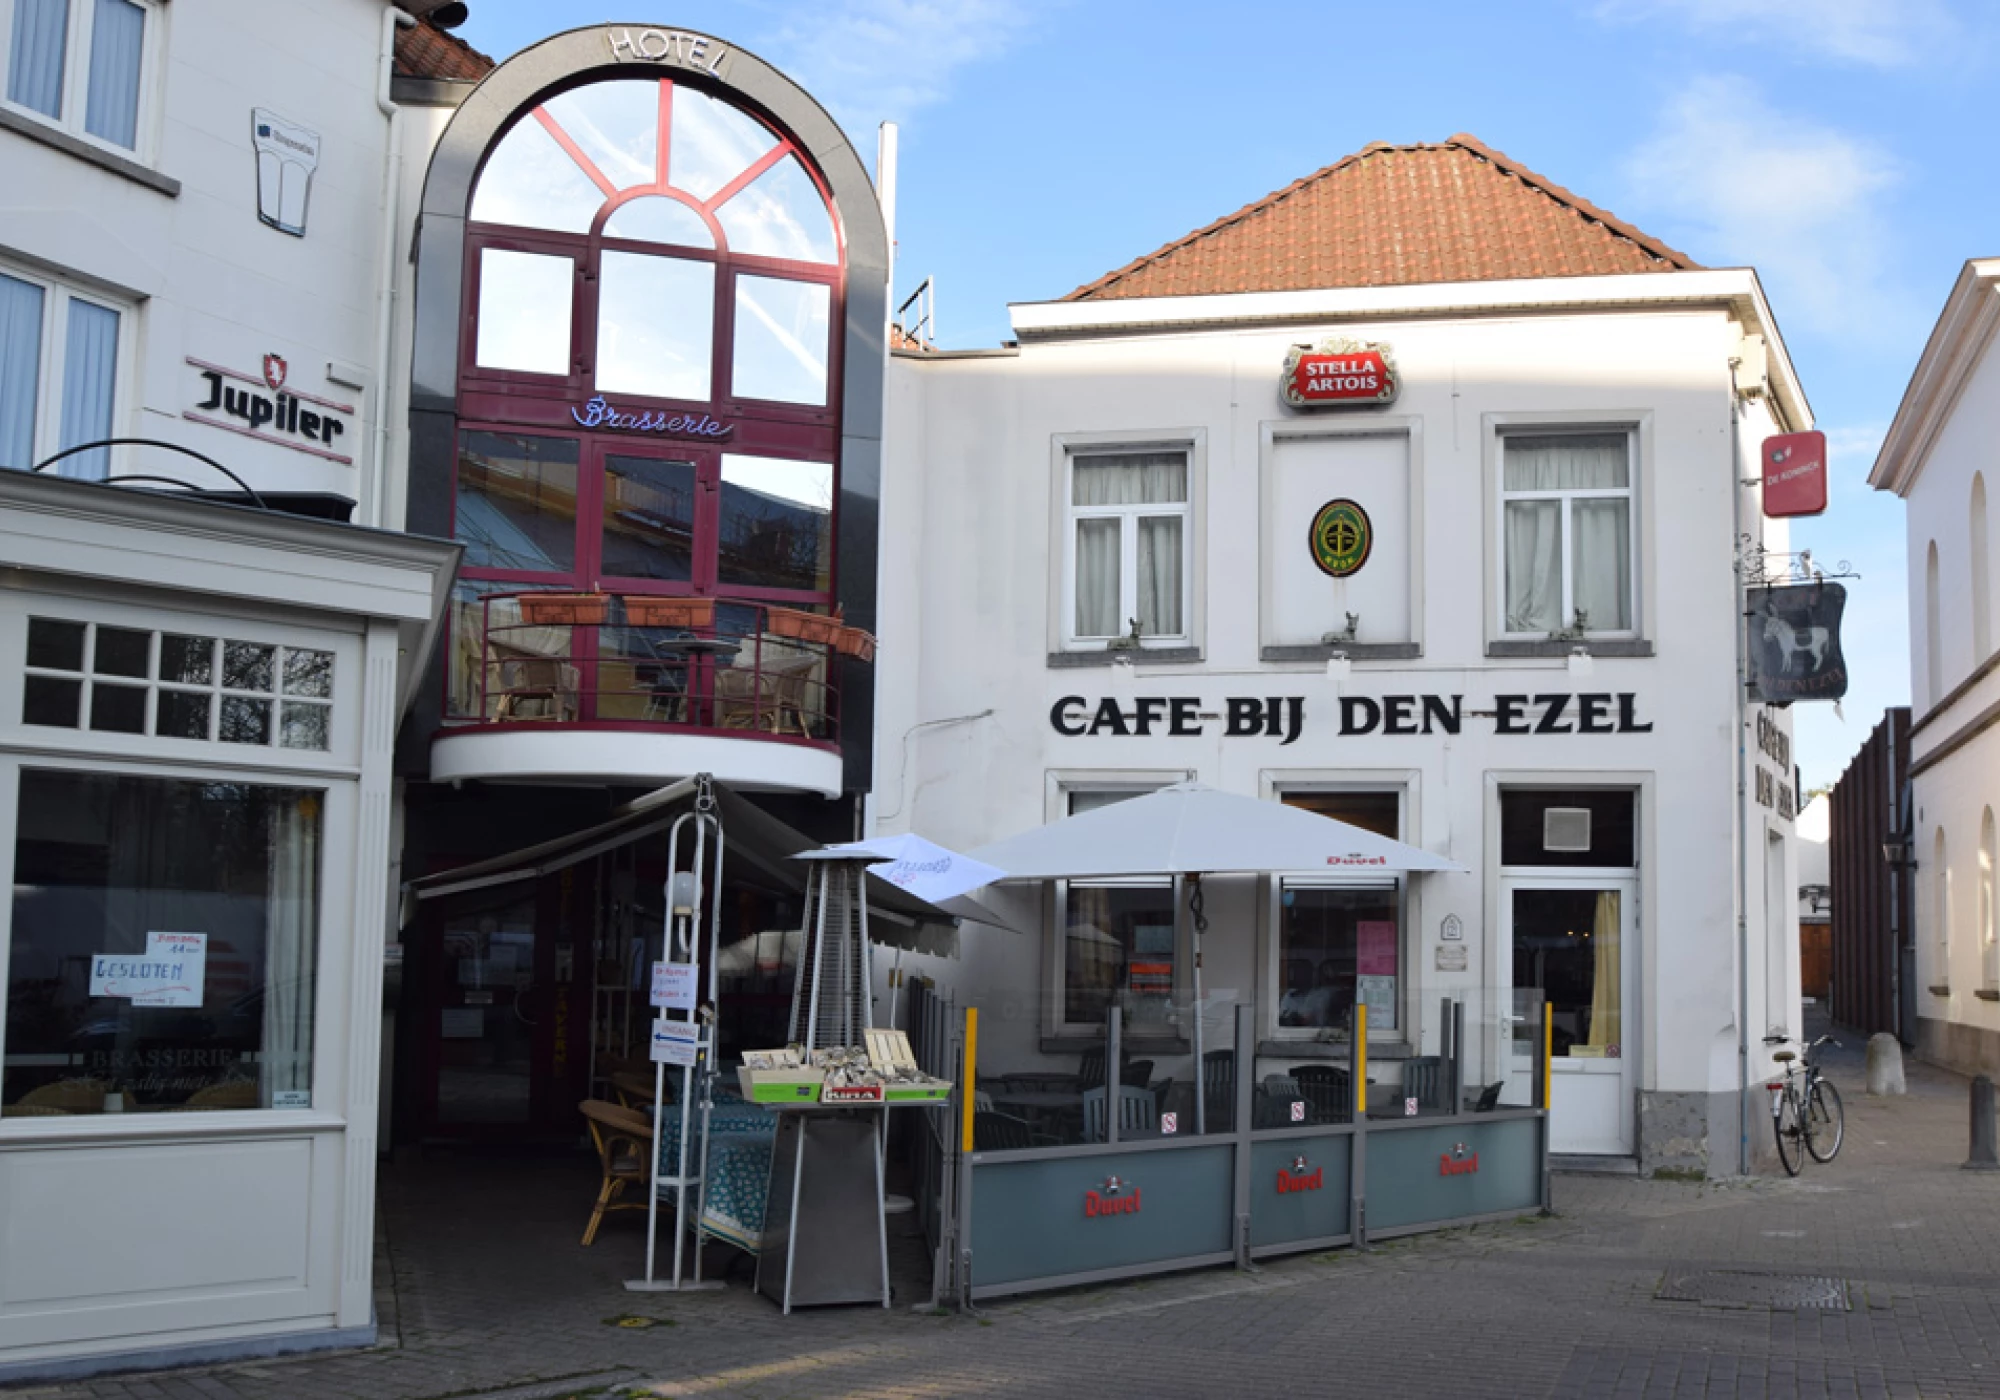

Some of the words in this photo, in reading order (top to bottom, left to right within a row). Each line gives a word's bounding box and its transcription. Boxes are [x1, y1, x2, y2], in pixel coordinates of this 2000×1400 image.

[607, 28, 725, 79] HOTEL
[1306, 360, 1376, 376] STELLA
[1306, 376, 1378, 391] ARTOIS
[196, 371, 344, 443] Jupiler
[571, 395, 735, 436] Brasserie
[1050, 695, 1202, 736] CAFE
[1224, 696, 1305, 746] BIJ
[1338, 694, 1463, 736] DEN
[1494, 692, 1653, 735] EZEL
[1440, 1151, 1479, 1177] Duvel
[1277, 1166, 1323, 1195] Duvel
[1085, 1187, 1141, 1218] Duvel
